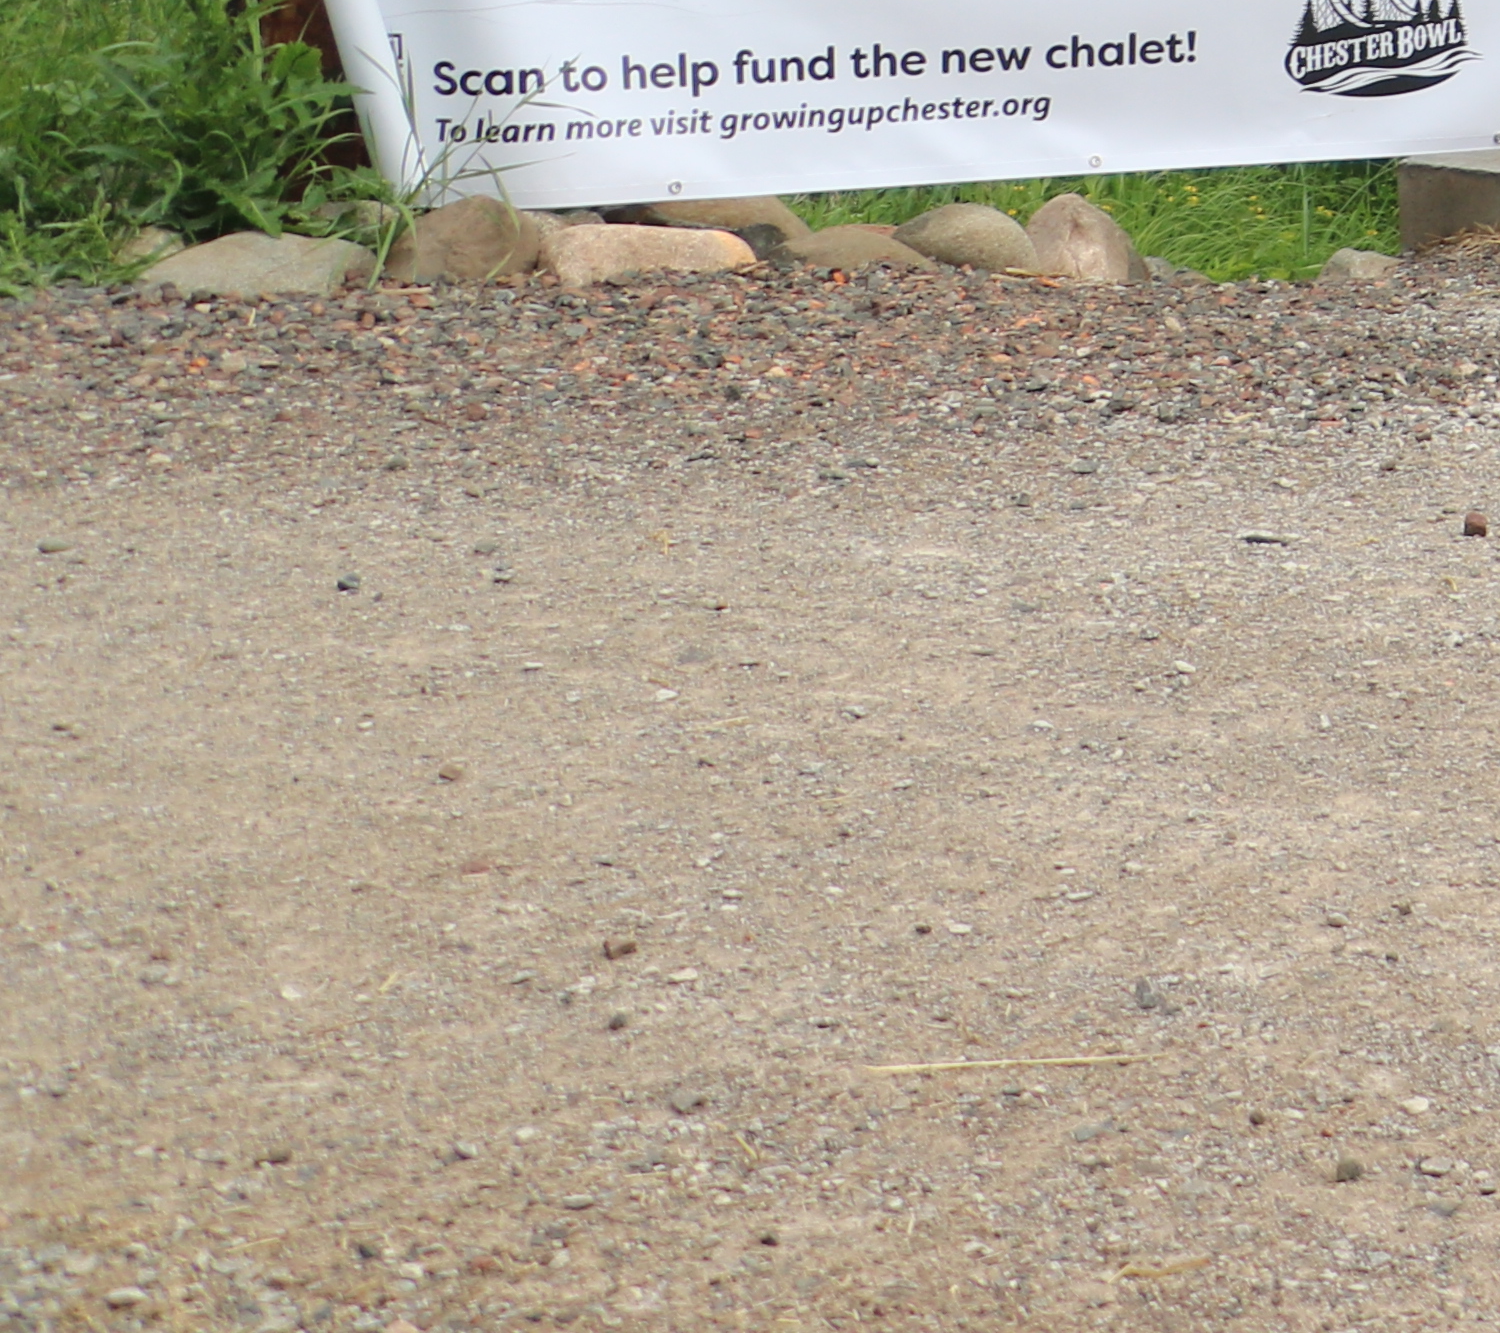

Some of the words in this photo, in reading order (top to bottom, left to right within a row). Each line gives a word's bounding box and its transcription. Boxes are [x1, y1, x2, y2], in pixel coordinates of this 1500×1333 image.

[433, 60, 546, 97] Scan
[558, 59, 608, 93] to
[621, 52, 720, 98] help
[733, 45, 836, 85] fund
[849, 43, 927, 79] the
[941, 45, 1032, 75] new
[1044, 30, 1198, 70] chalet!
[1289, 30, 1394, 80] CHESTER
[1395, 17, 1463, 61] BOWL
[435, 118, 468, 143] To
[475, 117, 556, 144] learn
[564, 116, 643, 142] more
[650, 107, 713, 137] visit
[719, 94, 1053, 140] growingupchester.org
